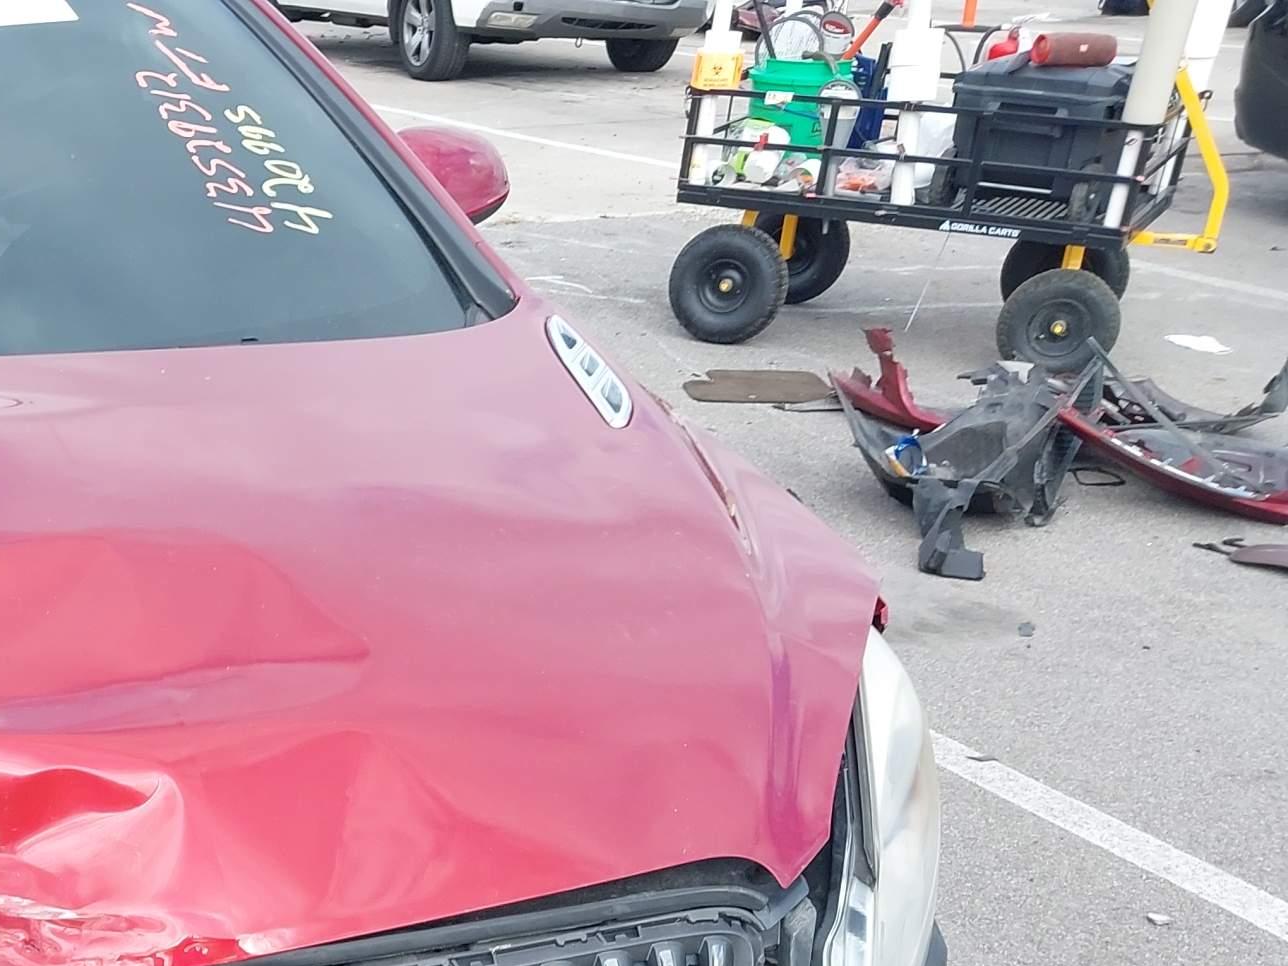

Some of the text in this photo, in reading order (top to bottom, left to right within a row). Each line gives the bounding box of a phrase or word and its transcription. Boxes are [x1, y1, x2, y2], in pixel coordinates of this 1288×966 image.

[135, 70, 274, 234] 43529312
[223, 104, 334, 235] 420995
[950, 222, 988, 234] GORILLA
